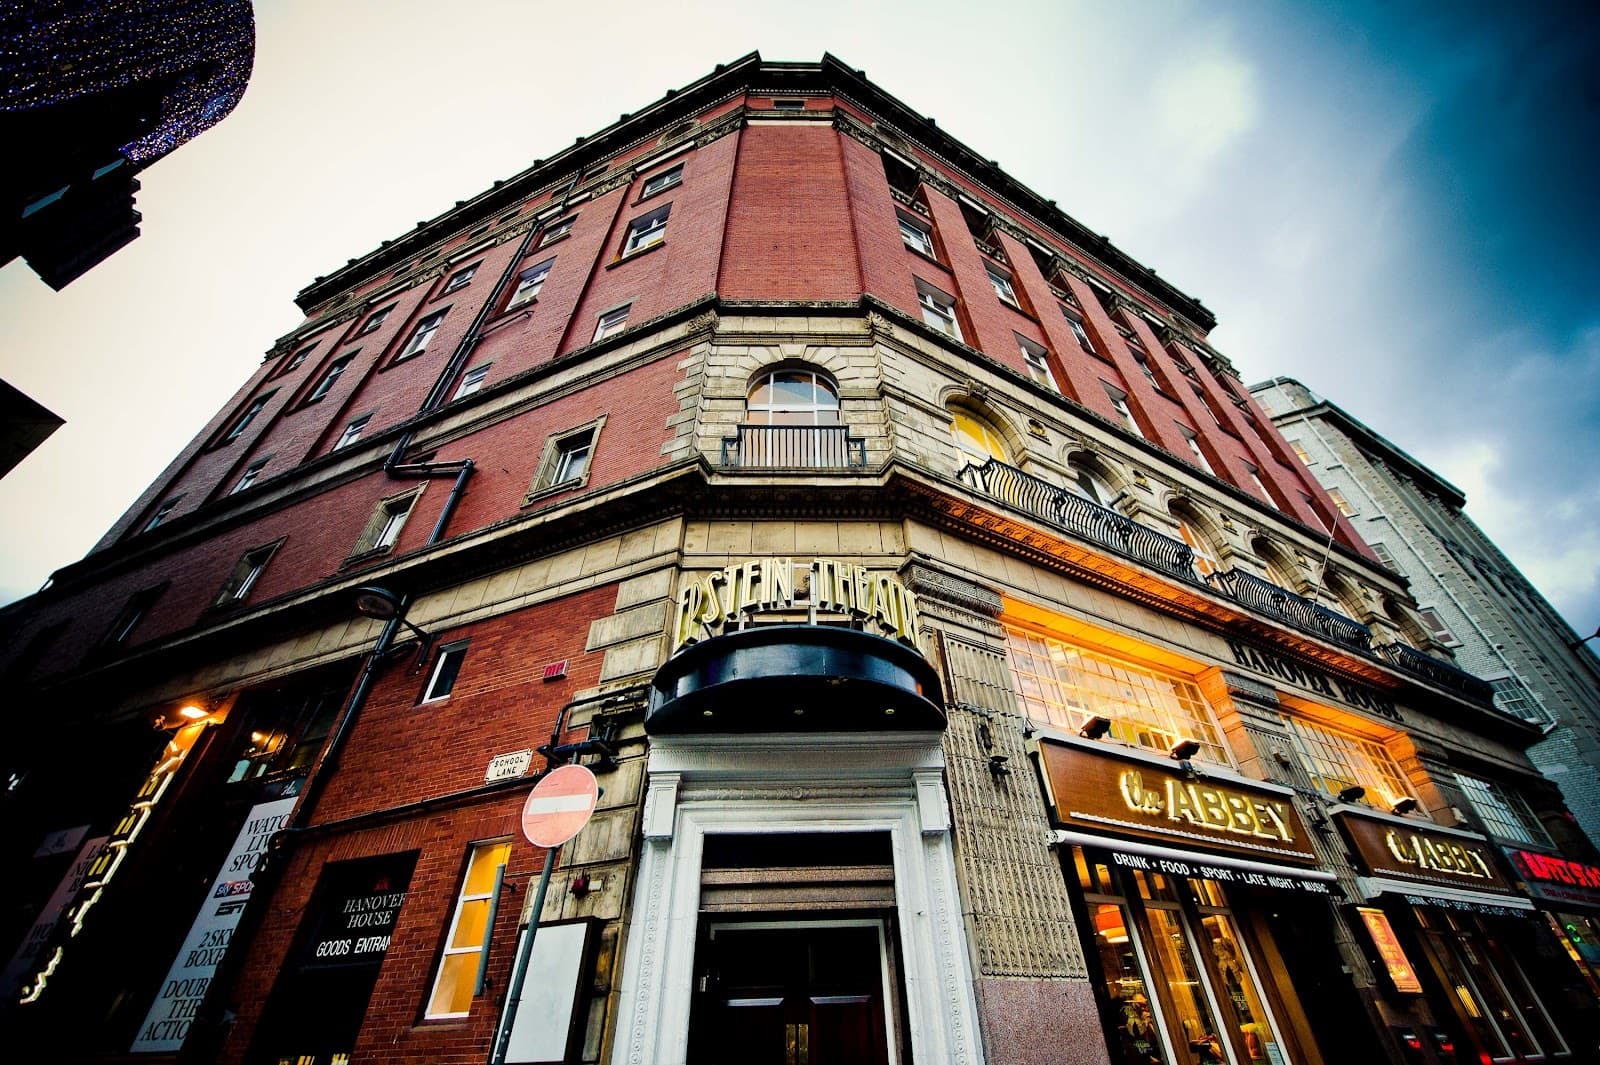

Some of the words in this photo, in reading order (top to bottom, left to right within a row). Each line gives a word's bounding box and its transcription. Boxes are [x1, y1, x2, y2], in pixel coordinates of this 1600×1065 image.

[671, 558, 793, 656] EPSTEIN
[494, 756, 524, 768] SCHOOL
[497, 766, 517, 777] LANE
[1120, 770, 1165, 814] the
[1165, 779, 1296, 842] ABBEY
[1112, 853, 1150, 870] DRINK
[1160, 860, 1190, 876] FOOD
[1202, 866, 1235, 882] SPORT
[1243, 873, 1268, 888] LATE
[1267, 876, 1295, 890] NIGHT
[1301, 881, 1330, 895] MUSIC
[347, 910, 393, 928] HOUSE
[316, 939, 352, 957] GOODS
